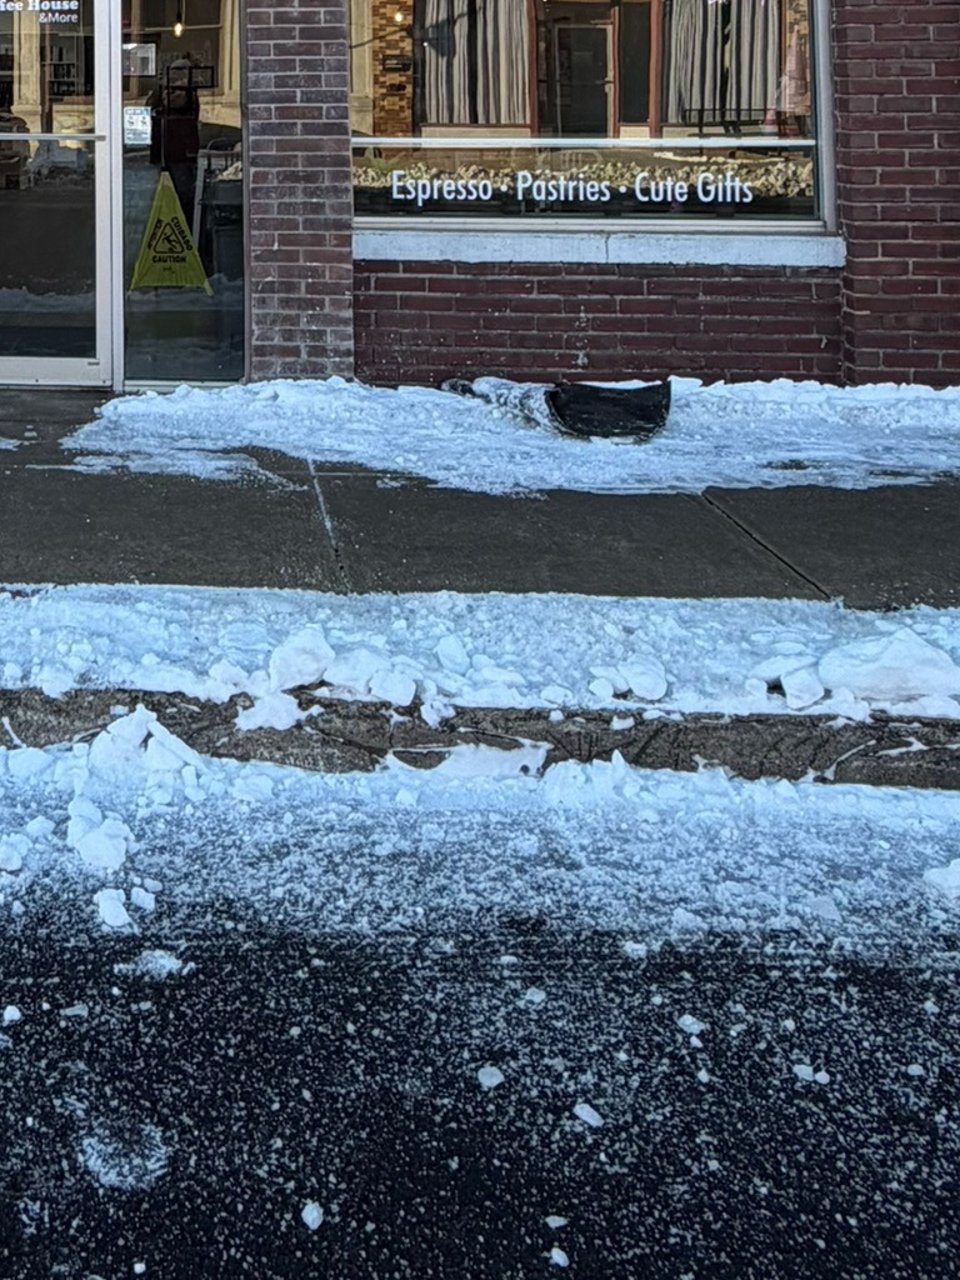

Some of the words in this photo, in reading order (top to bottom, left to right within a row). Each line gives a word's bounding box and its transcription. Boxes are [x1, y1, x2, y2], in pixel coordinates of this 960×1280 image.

[38, 12, 78, 23] &More
[391, 170, 493, 207] Espresso
[516, 171, 611, 202] Pastries
[634, 172, 689, 203] Cute
[696, 170, 754, 204] Gifts
[151, 255, 187, 264] CAUTION
